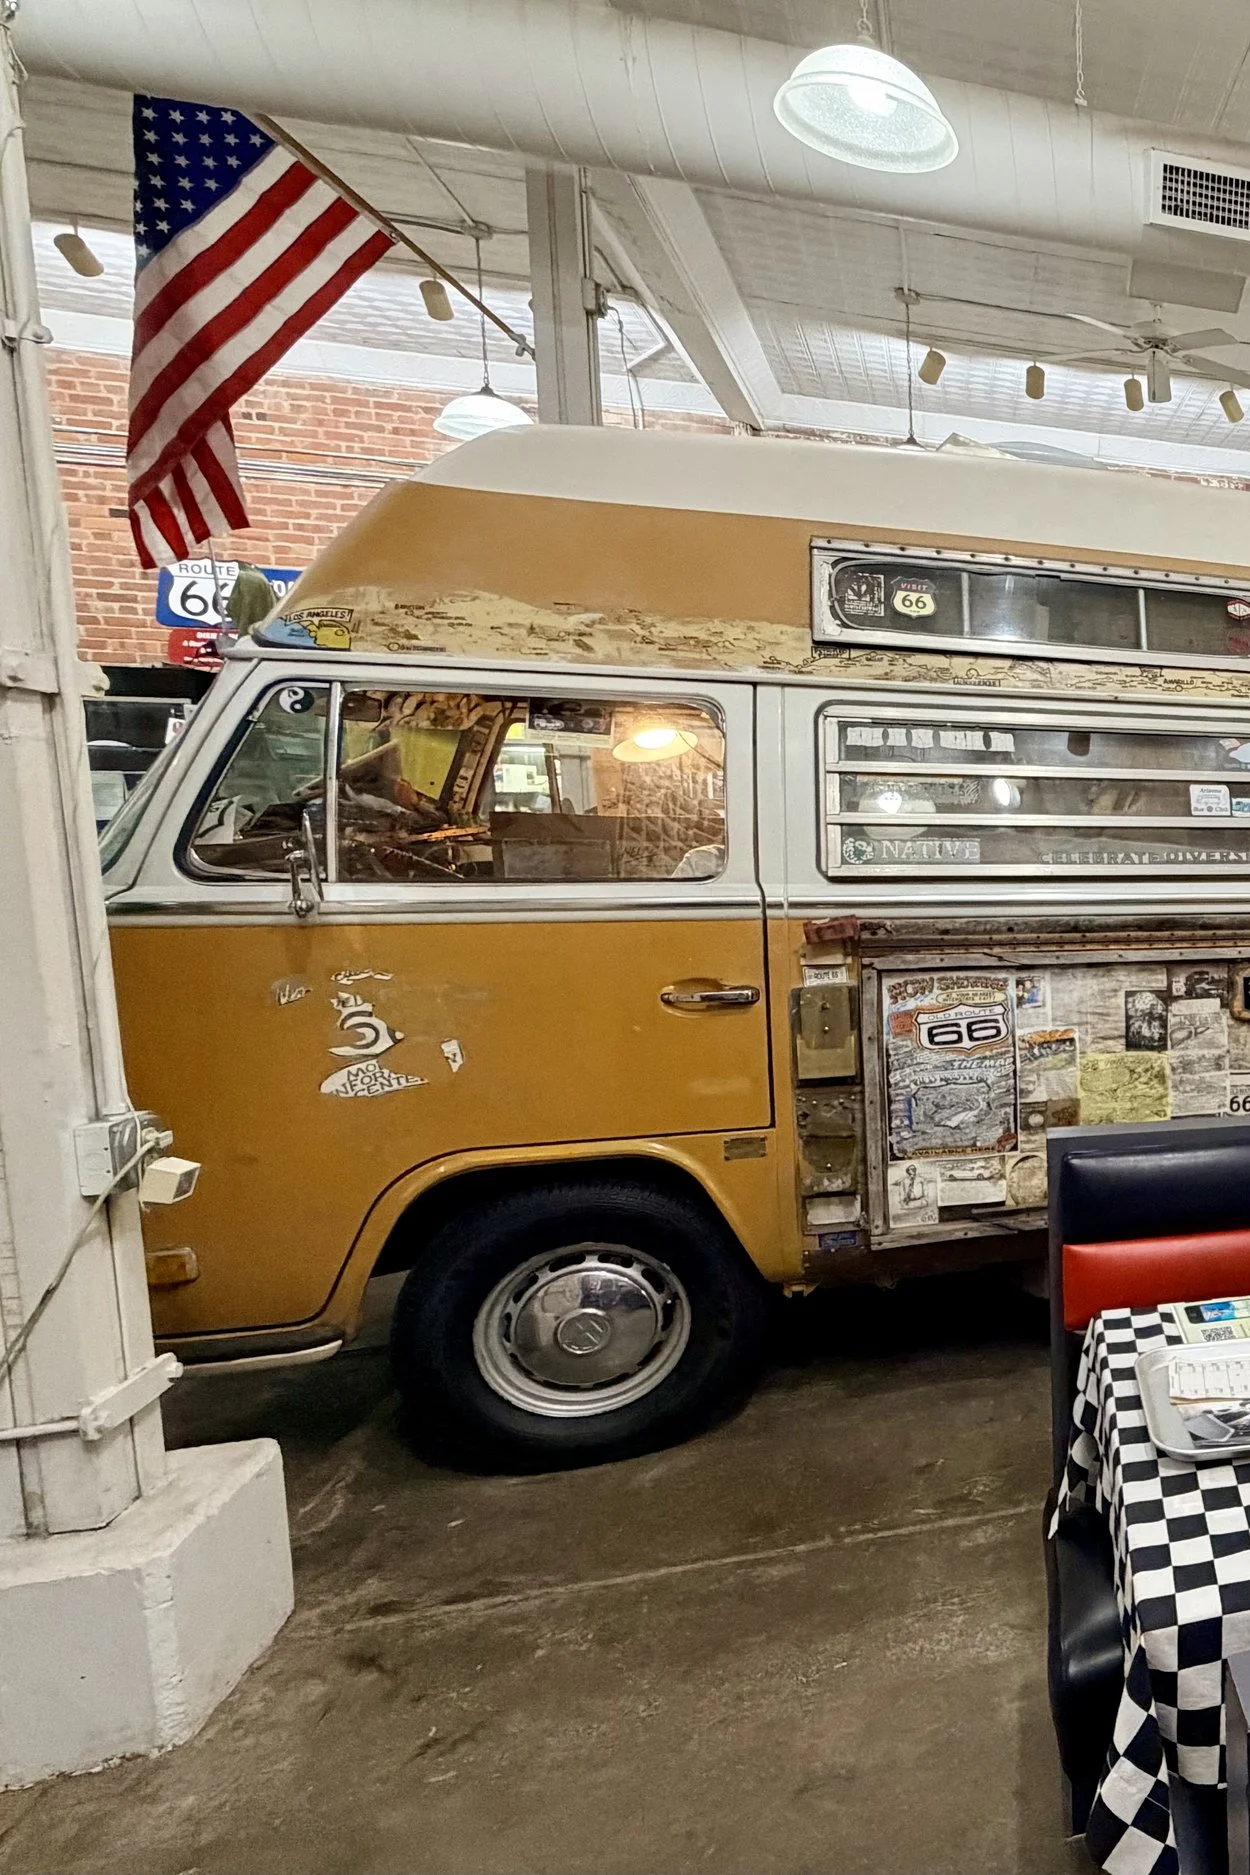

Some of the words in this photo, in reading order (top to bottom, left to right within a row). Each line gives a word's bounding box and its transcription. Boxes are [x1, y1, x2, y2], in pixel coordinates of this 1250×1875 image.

[178, 563, 237, 577] ROUTE
[900, 583, 928, 591] VISIT
[901, 594, 927, 609] 66
[288, 612, 304, 622] LOS
[881, 840, 980, 859] NATIVE
[927, 1012, 952, 1021] OLD
[954, 1008, 996, 1018] ROUTE
[927, 1018, 1002, 1046] 66
[347, 1062, 384, 1081] MO
[354, 1075, 426, 1097] CENTE
